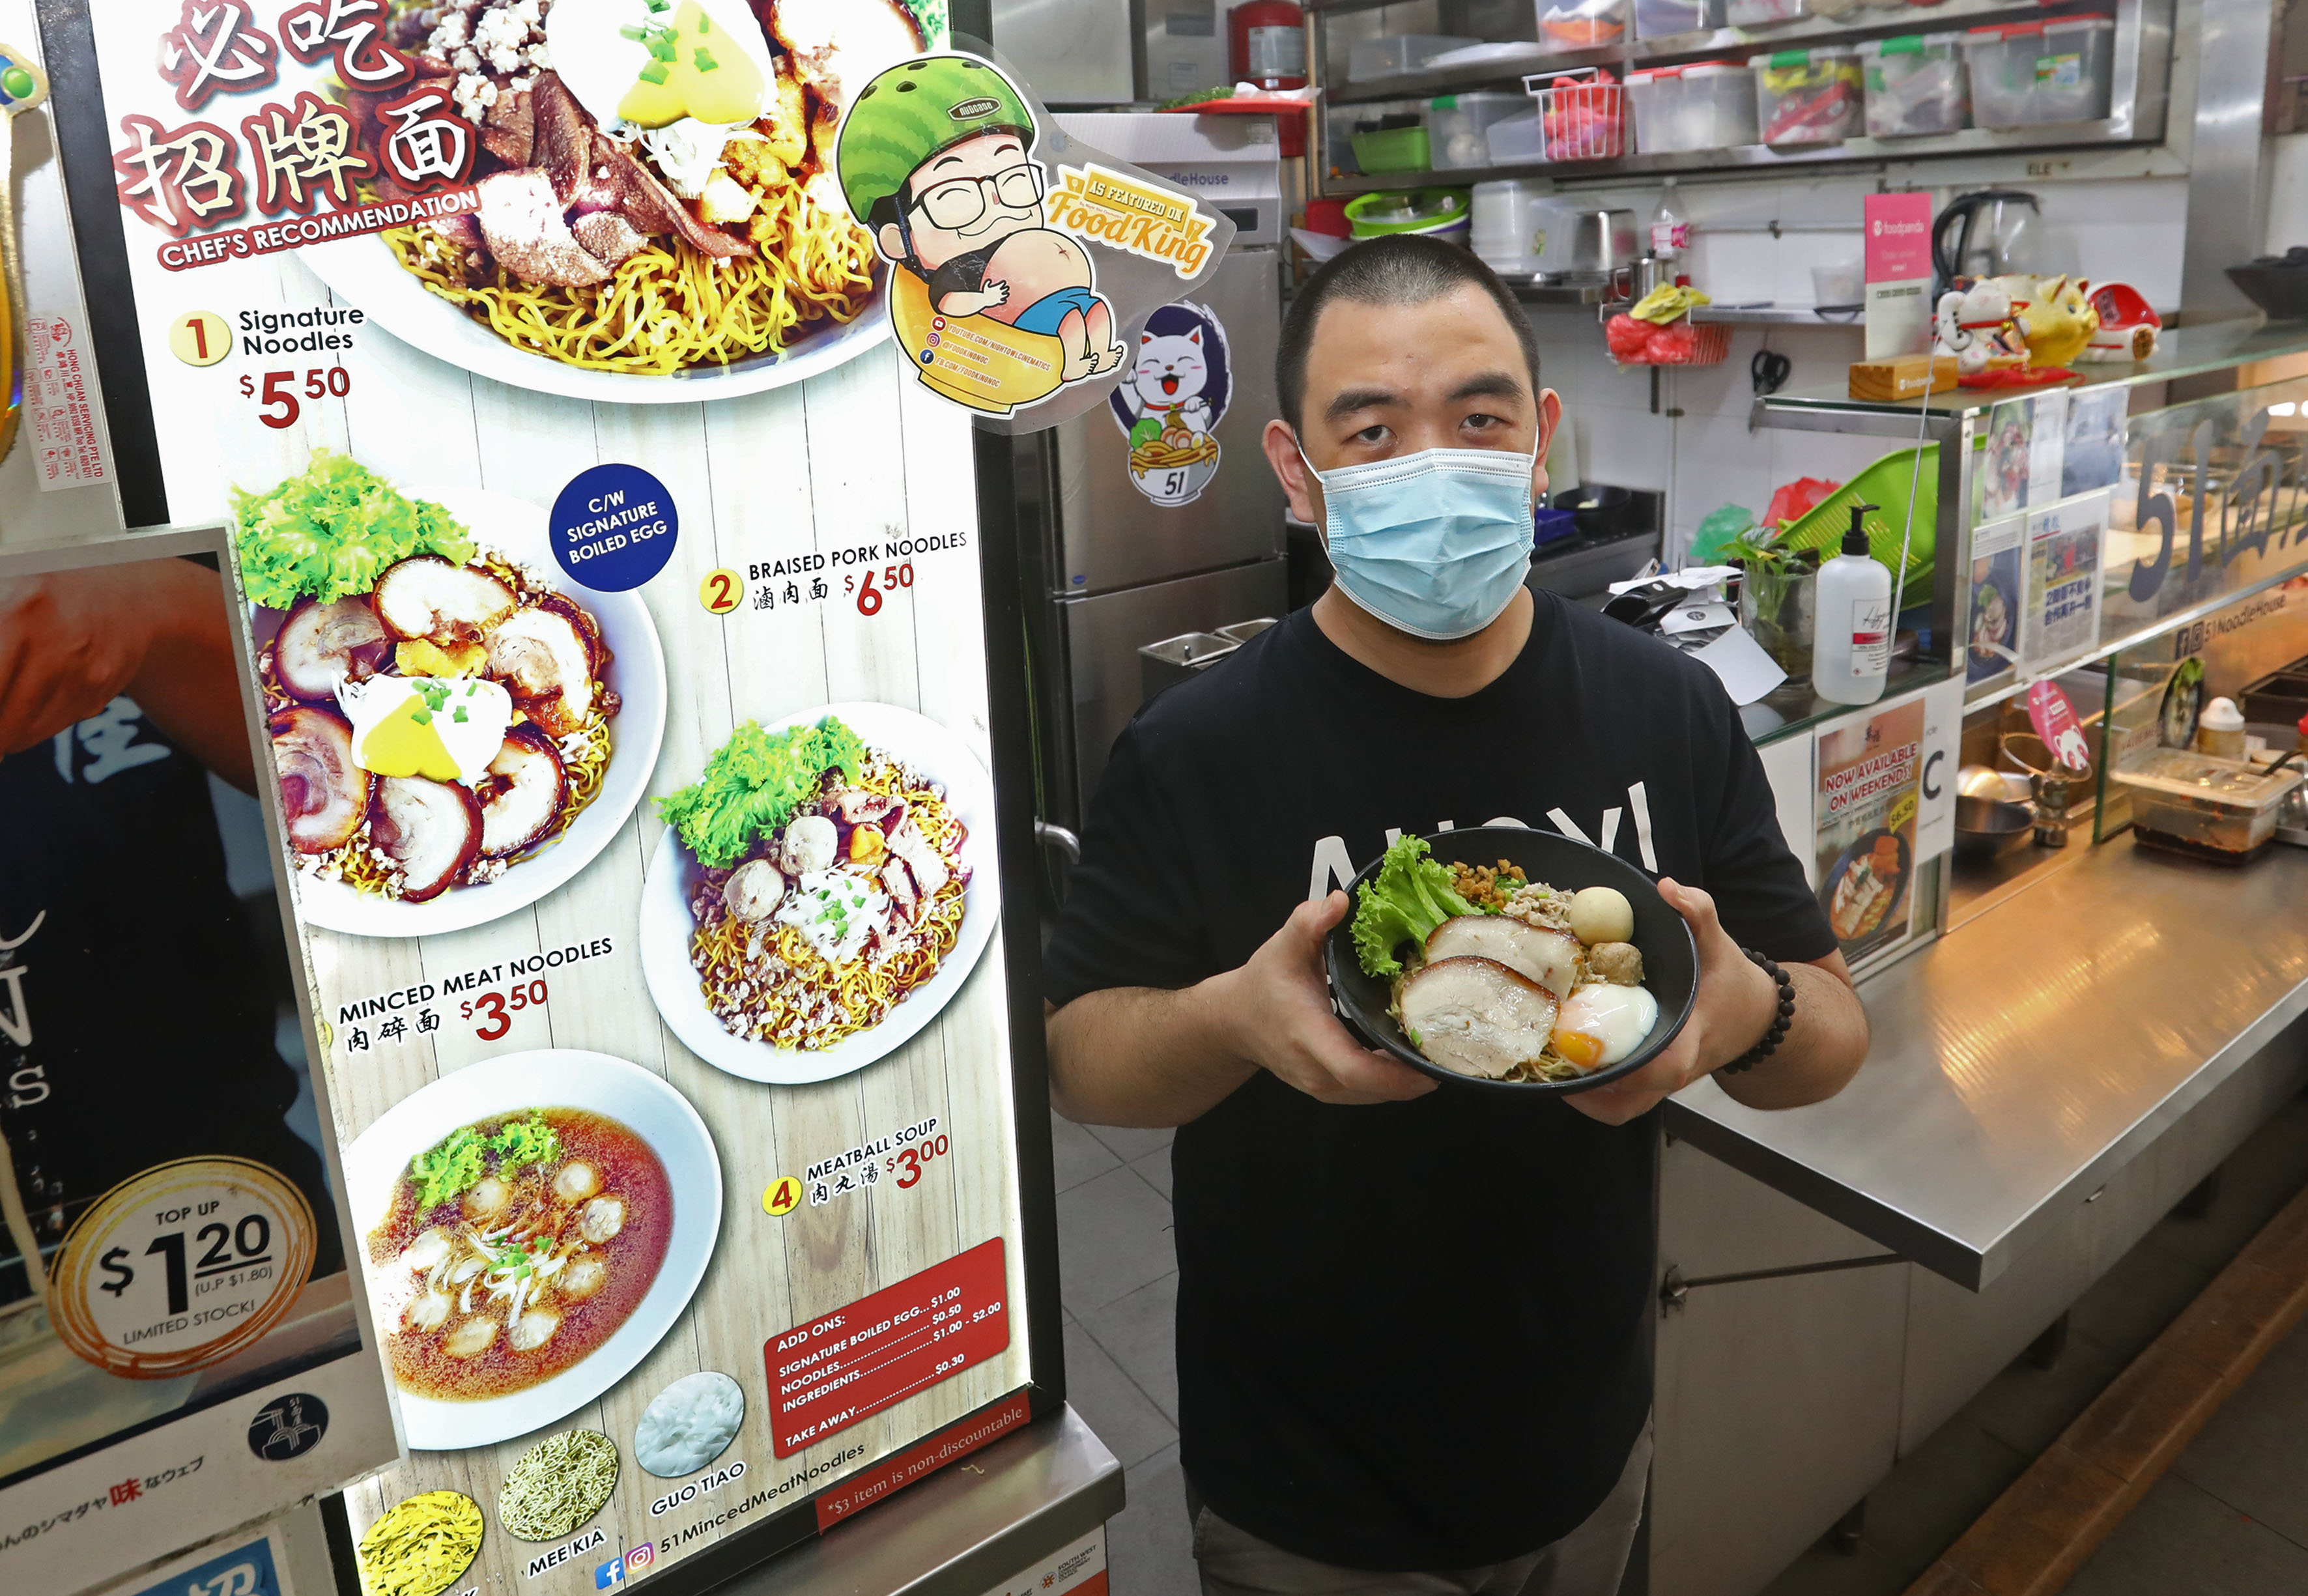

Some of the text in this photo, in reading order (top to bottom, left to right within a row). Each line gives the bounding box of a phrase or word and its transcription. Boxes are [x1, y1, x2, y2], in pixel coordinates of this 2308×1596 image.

[165, 0, 405, 99] 必吃
[117, 94, 468, 227] 招牌面
[1089, 181, 1184, 223] AS FEATURED ON
[162, 190, 478, 267] CHEF'S RECOMMENDATION
[186, 319, 208, 358] 1
[239, 306, 365, 335] Signature
[244, 330, 354, 356] Noodles
[66, 349, 104, 477] HONG CHUAN SERVICING PTE LTD
[588, 489, 625, 515] C/W
[1165, 471, 1184, 495] 51
[566, 501, 659, 543] SIGNATURE
[569, 519, 667, 565] BOILED EGG
[749, 532, 968, 580] BRAISED PORK NOODLES
[709, 573, 734, 610] 2
[1825, 742, 1917, 793] NOW AVAILABLE
[1831, 792, 1847, 811] ON
[1851, 765, 1913, 801] WEEKENDS!
[1922, 750, 1945, 800] C
[339, 937, 613, 1025] MINCED MEAT NOODLES
[806, 1118, 937, 1182] MEATBALL SOUP
[155, 1201, 220, 1225] TOP UP
[771, 1180, 793, 1209] 4
[123, 1300, 256, 1345] LIMITED STOCK!
[776, 1313, 847, 1353] ADD ONS:
[778, 1339, 848, 1378] SIGNATURE
[849, 1319, 892, 1347] BOILED
[930, 1287, 962, 1309] $1.00
[932, 1303, 962, 1325] $0.50
[933, 1320, 963, 1342] $1.00
[973, 1302, 1002, 1323] $2.00
[786, 1425, 816, 1448] TAKE
[935, 1352, 965, 1376] $0.30
[854, 1478, 888, 1503] item
[891, 1470, 904, 1486] is
[907, 1405, 1023, 1476] non-discountable
[651, 1462, 746, 1516] GUO TIAO
[660, 1444, 865, 1554] 51MincedMeatNoodles
[528, 1530, 606, 1577] MEE KIA
[1058, 1554, 1079, 1569] SOUTH
